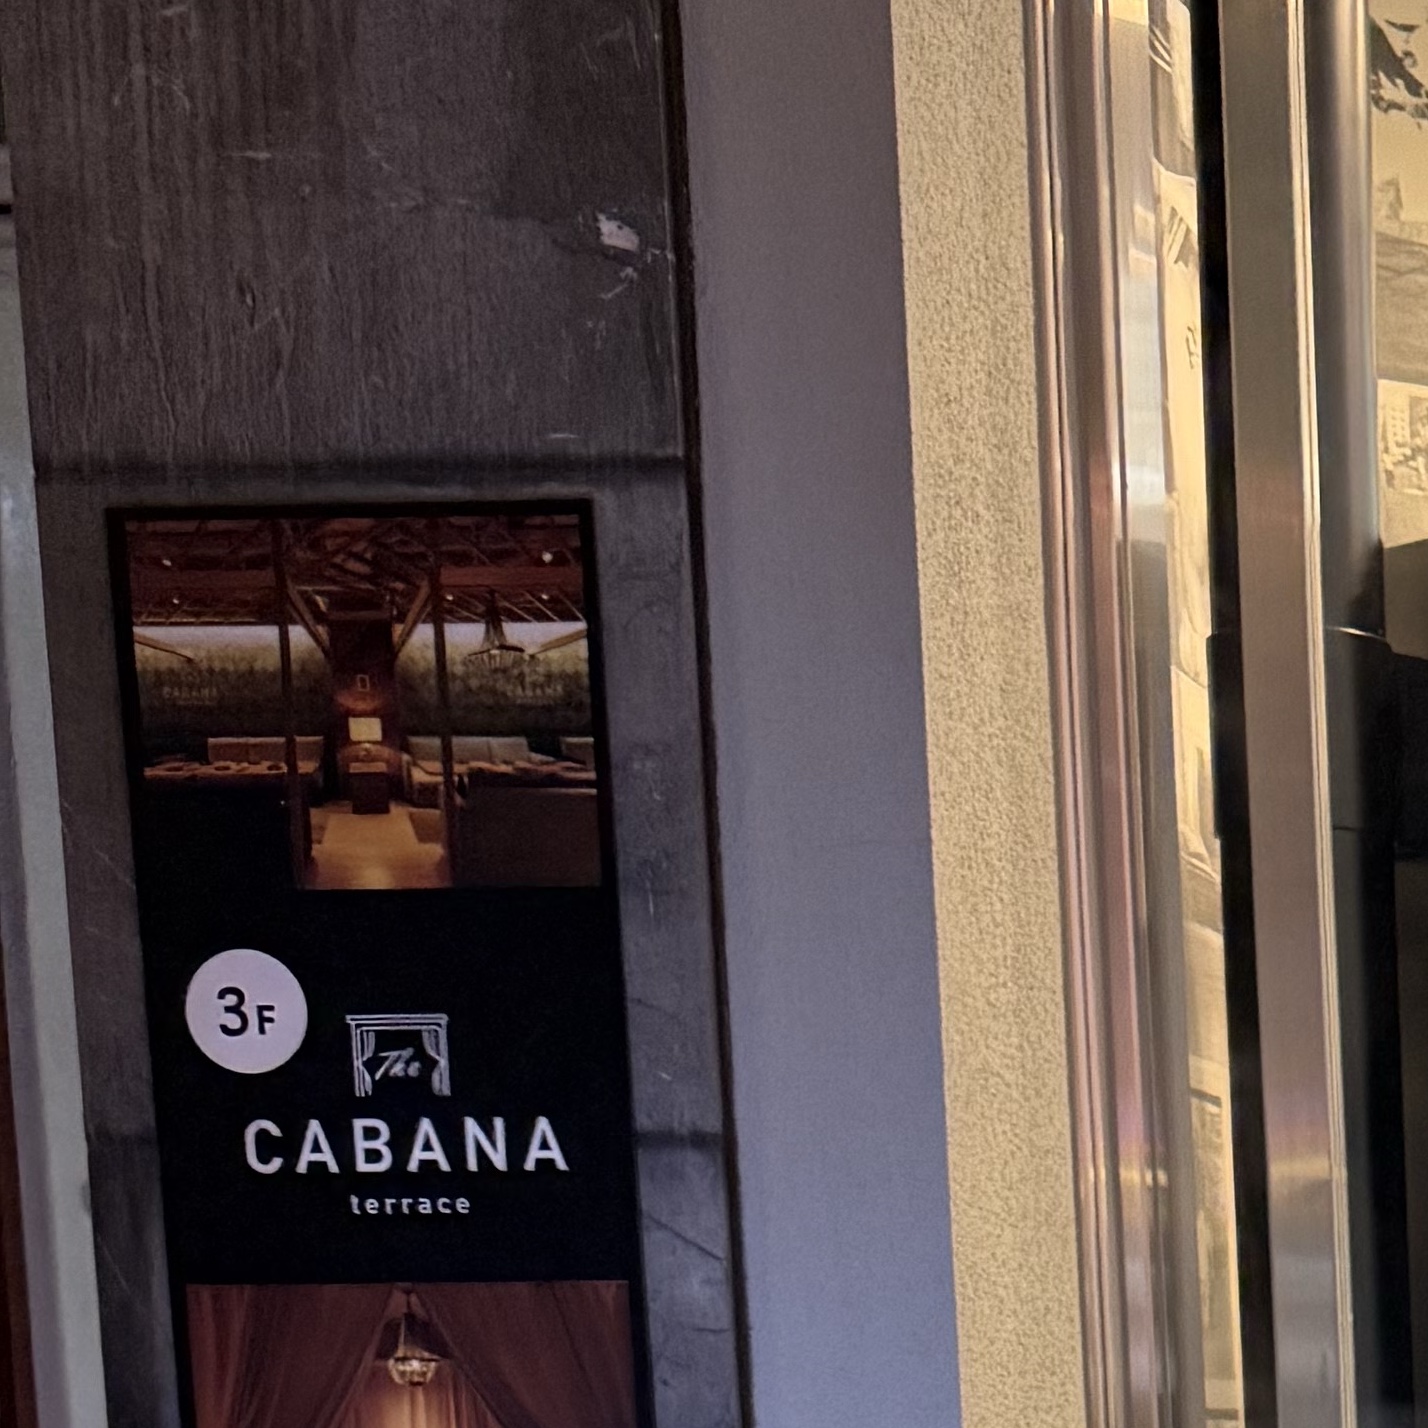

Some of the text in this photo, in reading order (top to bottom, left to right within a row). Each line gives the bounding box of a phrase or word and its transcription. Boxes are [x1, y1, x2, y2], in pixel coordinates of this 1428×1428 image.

[216, 986, 276, 1037] 3F
[244, 1116, 570, 1174] CABANA
[350, 1195, 471, 1215] terrace
